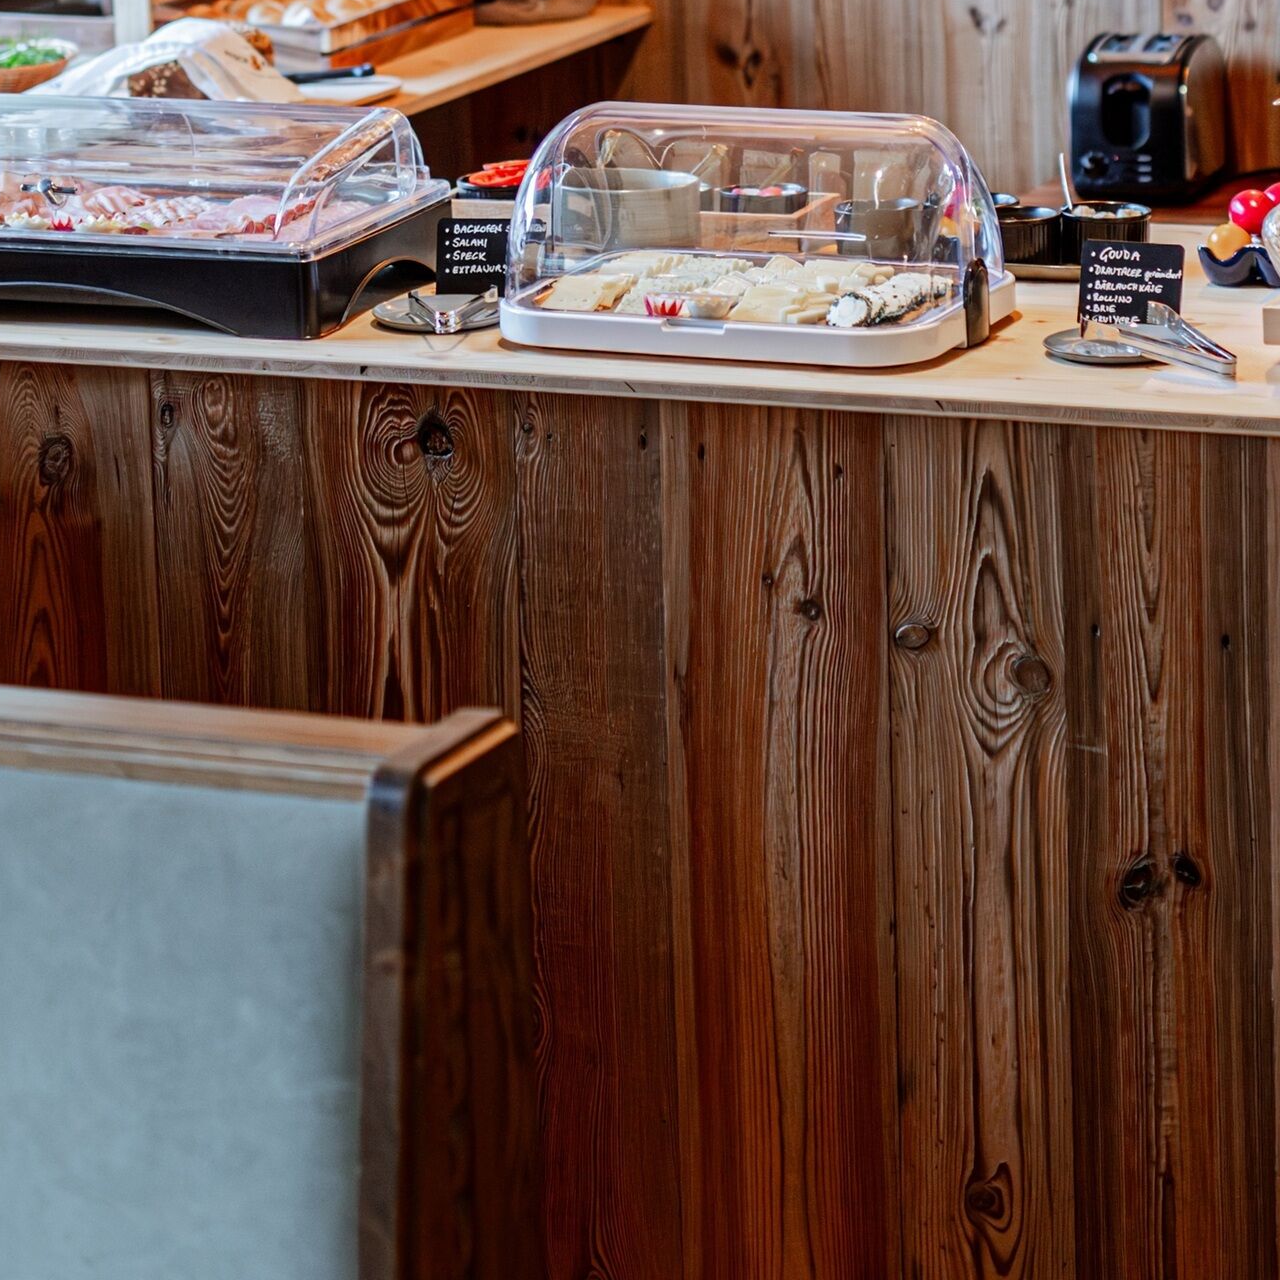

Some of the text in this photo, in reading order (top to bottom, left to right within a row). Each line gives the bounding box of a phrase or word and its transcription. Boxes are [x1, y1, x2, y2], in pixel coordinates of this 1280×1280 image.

[453, 223, 502, 234] BACKOFEN
[452, 250, 487, 261] SPECK
[1099, 246, 1141, 263] GOUDA
[452, 263, 508, 275] EXTRAWURS
[1093, 304, 1117, 313] BRIE
